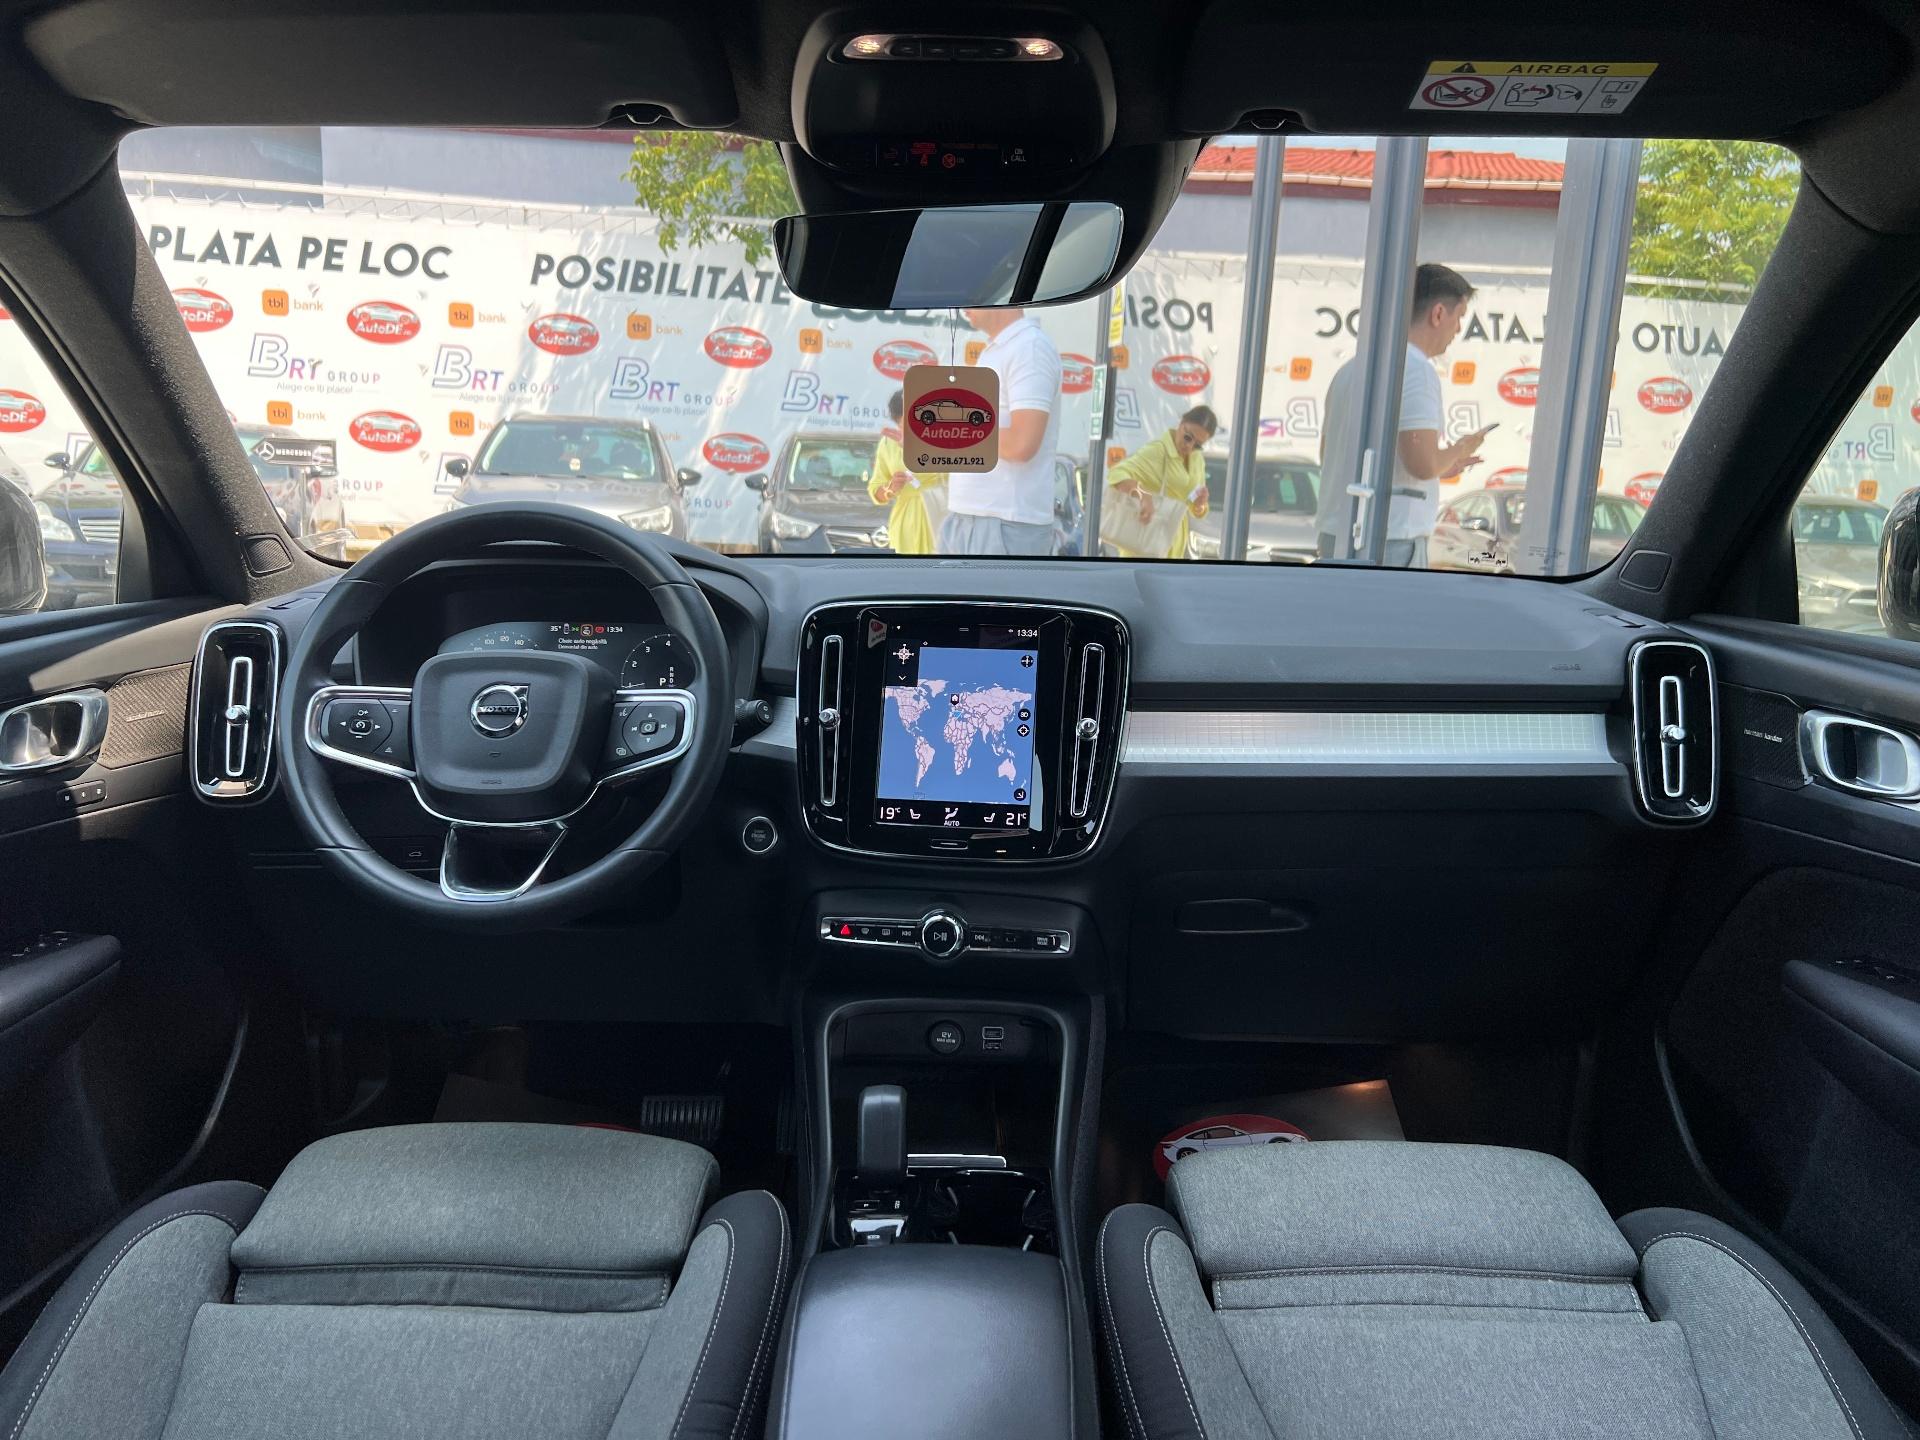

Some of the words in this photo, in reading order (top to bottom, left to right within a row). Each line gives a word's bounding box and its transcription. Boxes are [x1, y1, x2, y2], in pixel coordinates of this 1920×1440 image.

[1506, 64, 1611, 74] AIRBAG
[150, 225, 282, 268] PLATA
[297, 236, 348, 272] PE
[359, 239, 453, 280] LOC
[530, 253, 791, 305] POSIBILITATE
[268, 298, 284, 309] tbi
[294, 299, 324, 312] bank
[454, 311, 469, 321] tbi
[478, 312, 507, 323] bank
[632, 322, 648, 332] tbi
[656, 325, 684, 336] bank
[247, 333, 323, 381] BRT
[327, 370, 381, 384] GROUP
[432, 344, 504, 391] BRT
[508, 382, 560, 394] GROUP
[609, 356, 680, 402] BRT
[684, 394, 734, 407] GROUP
[781, 370, 849, 415] BRT
[273, 408, 288, 418] tbi
[297, 410, 326, 421] bank
[455, 418, 470, 428] tbi
[921, 427, 984, 439] AutoDE.ro
[931, 457, 984, 465] 0758.671.921
[1017, 629, 1038, 637] 13:34
[631, 660, 638, 668] 2
[659, 677, 667, 686] P
